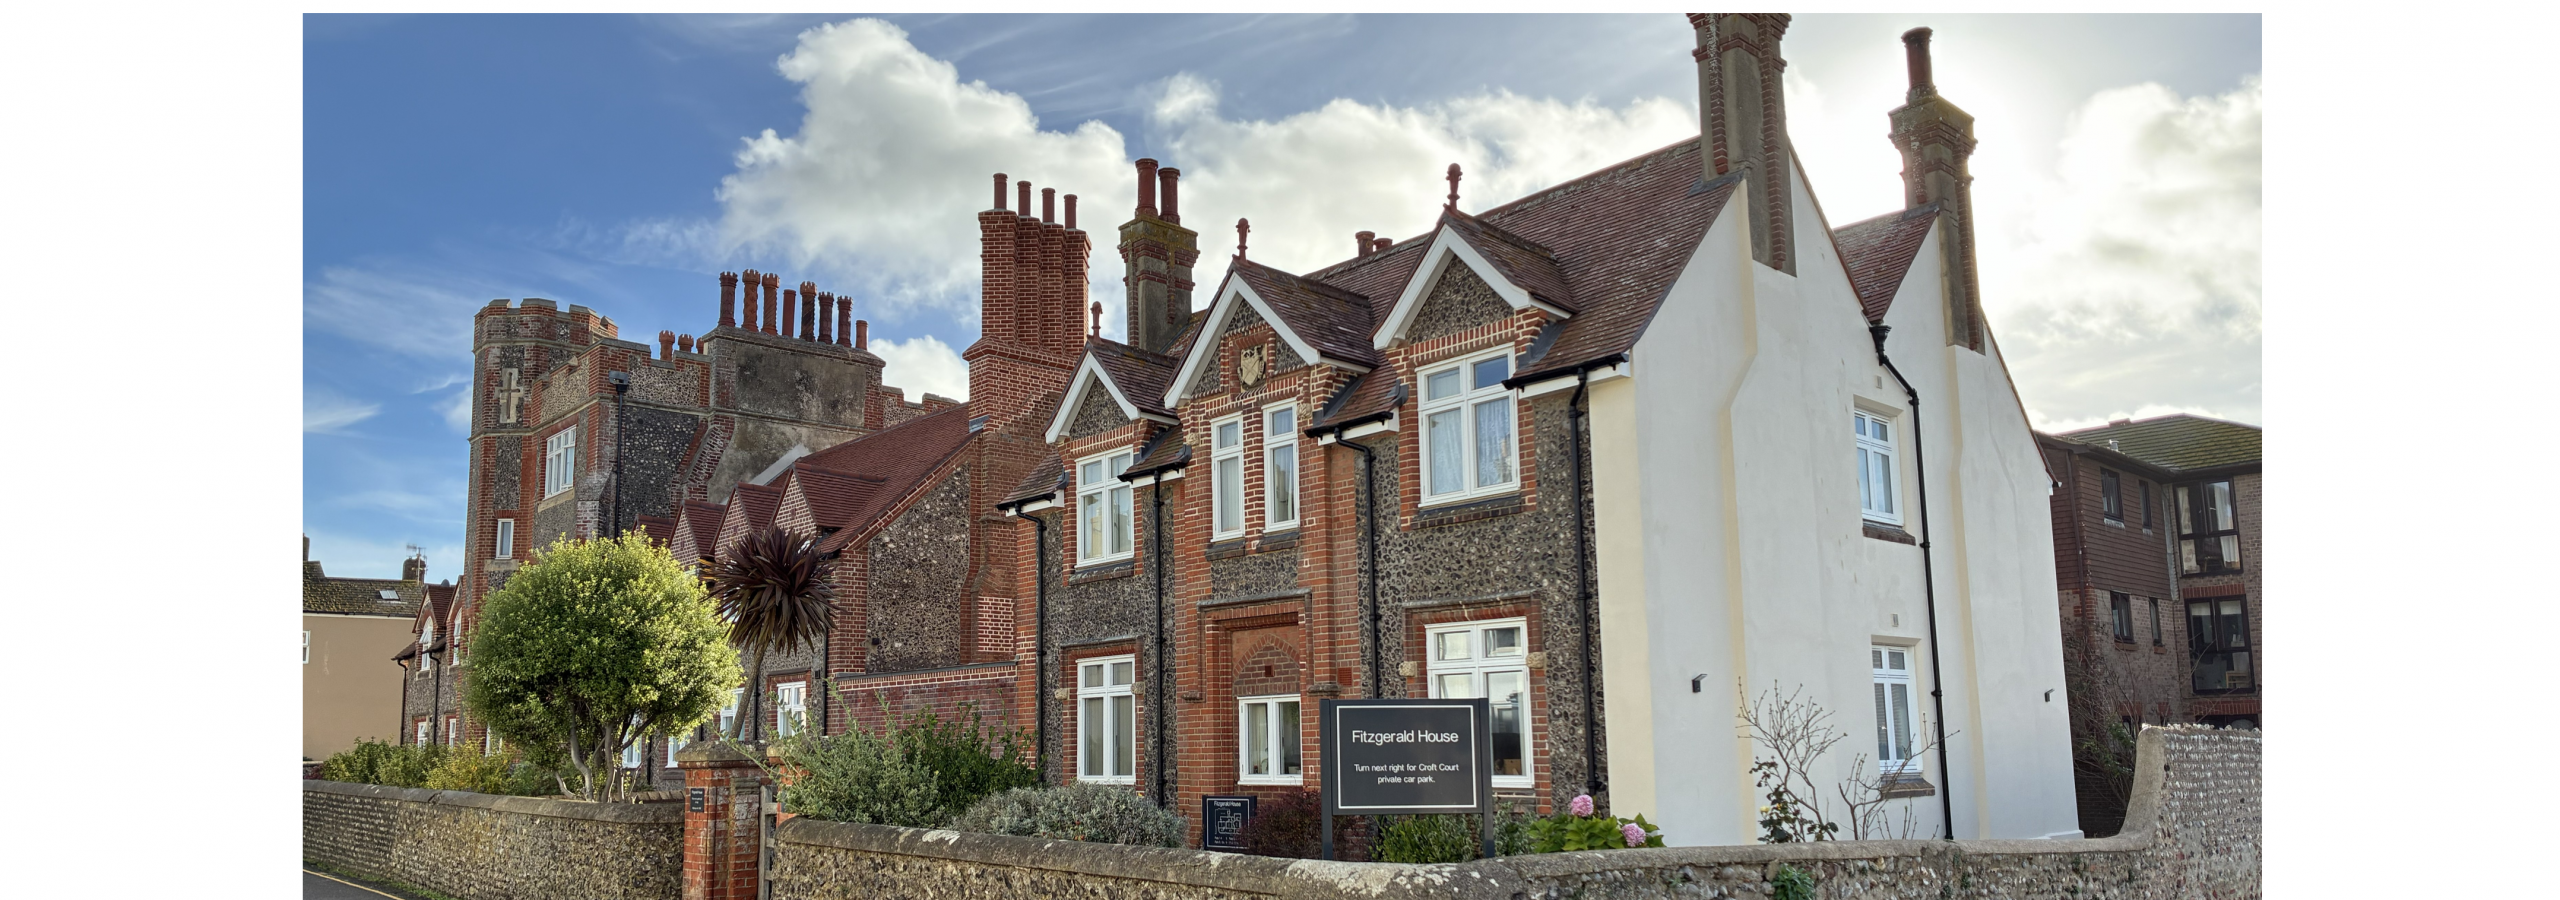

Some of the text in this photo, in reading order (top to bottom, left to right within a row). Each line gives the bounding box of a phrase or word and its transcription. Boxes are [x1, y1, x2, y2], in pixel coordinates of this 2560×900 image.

[1352, 730, 1459, 746] Fitzgerald House
[1354, 763, 1459, 774] Turn next right for Croft Court
[1377, 775, 1402, 785] private
[1417, 775, 1436, 784] park.
